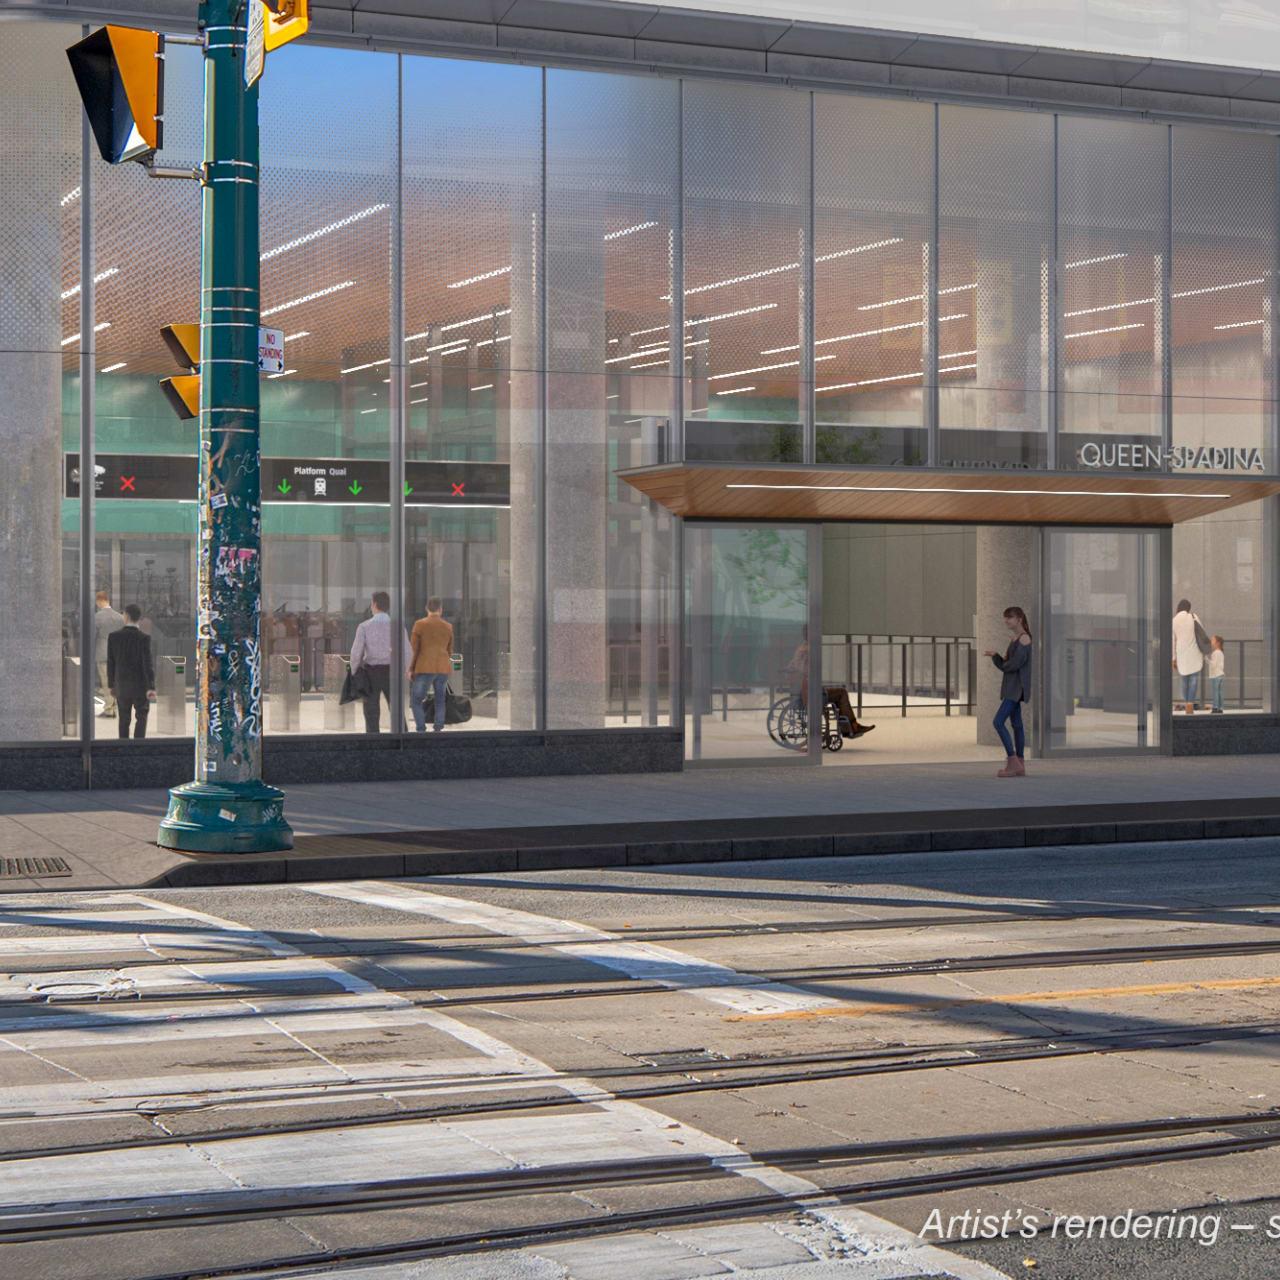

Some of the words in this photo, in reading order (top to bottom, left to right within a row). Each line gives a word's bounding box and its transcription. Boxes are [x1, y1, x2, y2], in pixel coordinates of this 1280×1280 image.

[266, 333, 276, 345] NO
[1080, 442, 1266, 471] QUEEN-SPADINA
[293, 466, 326, 476] Platform
[329, 467, 347, 477] Quai
